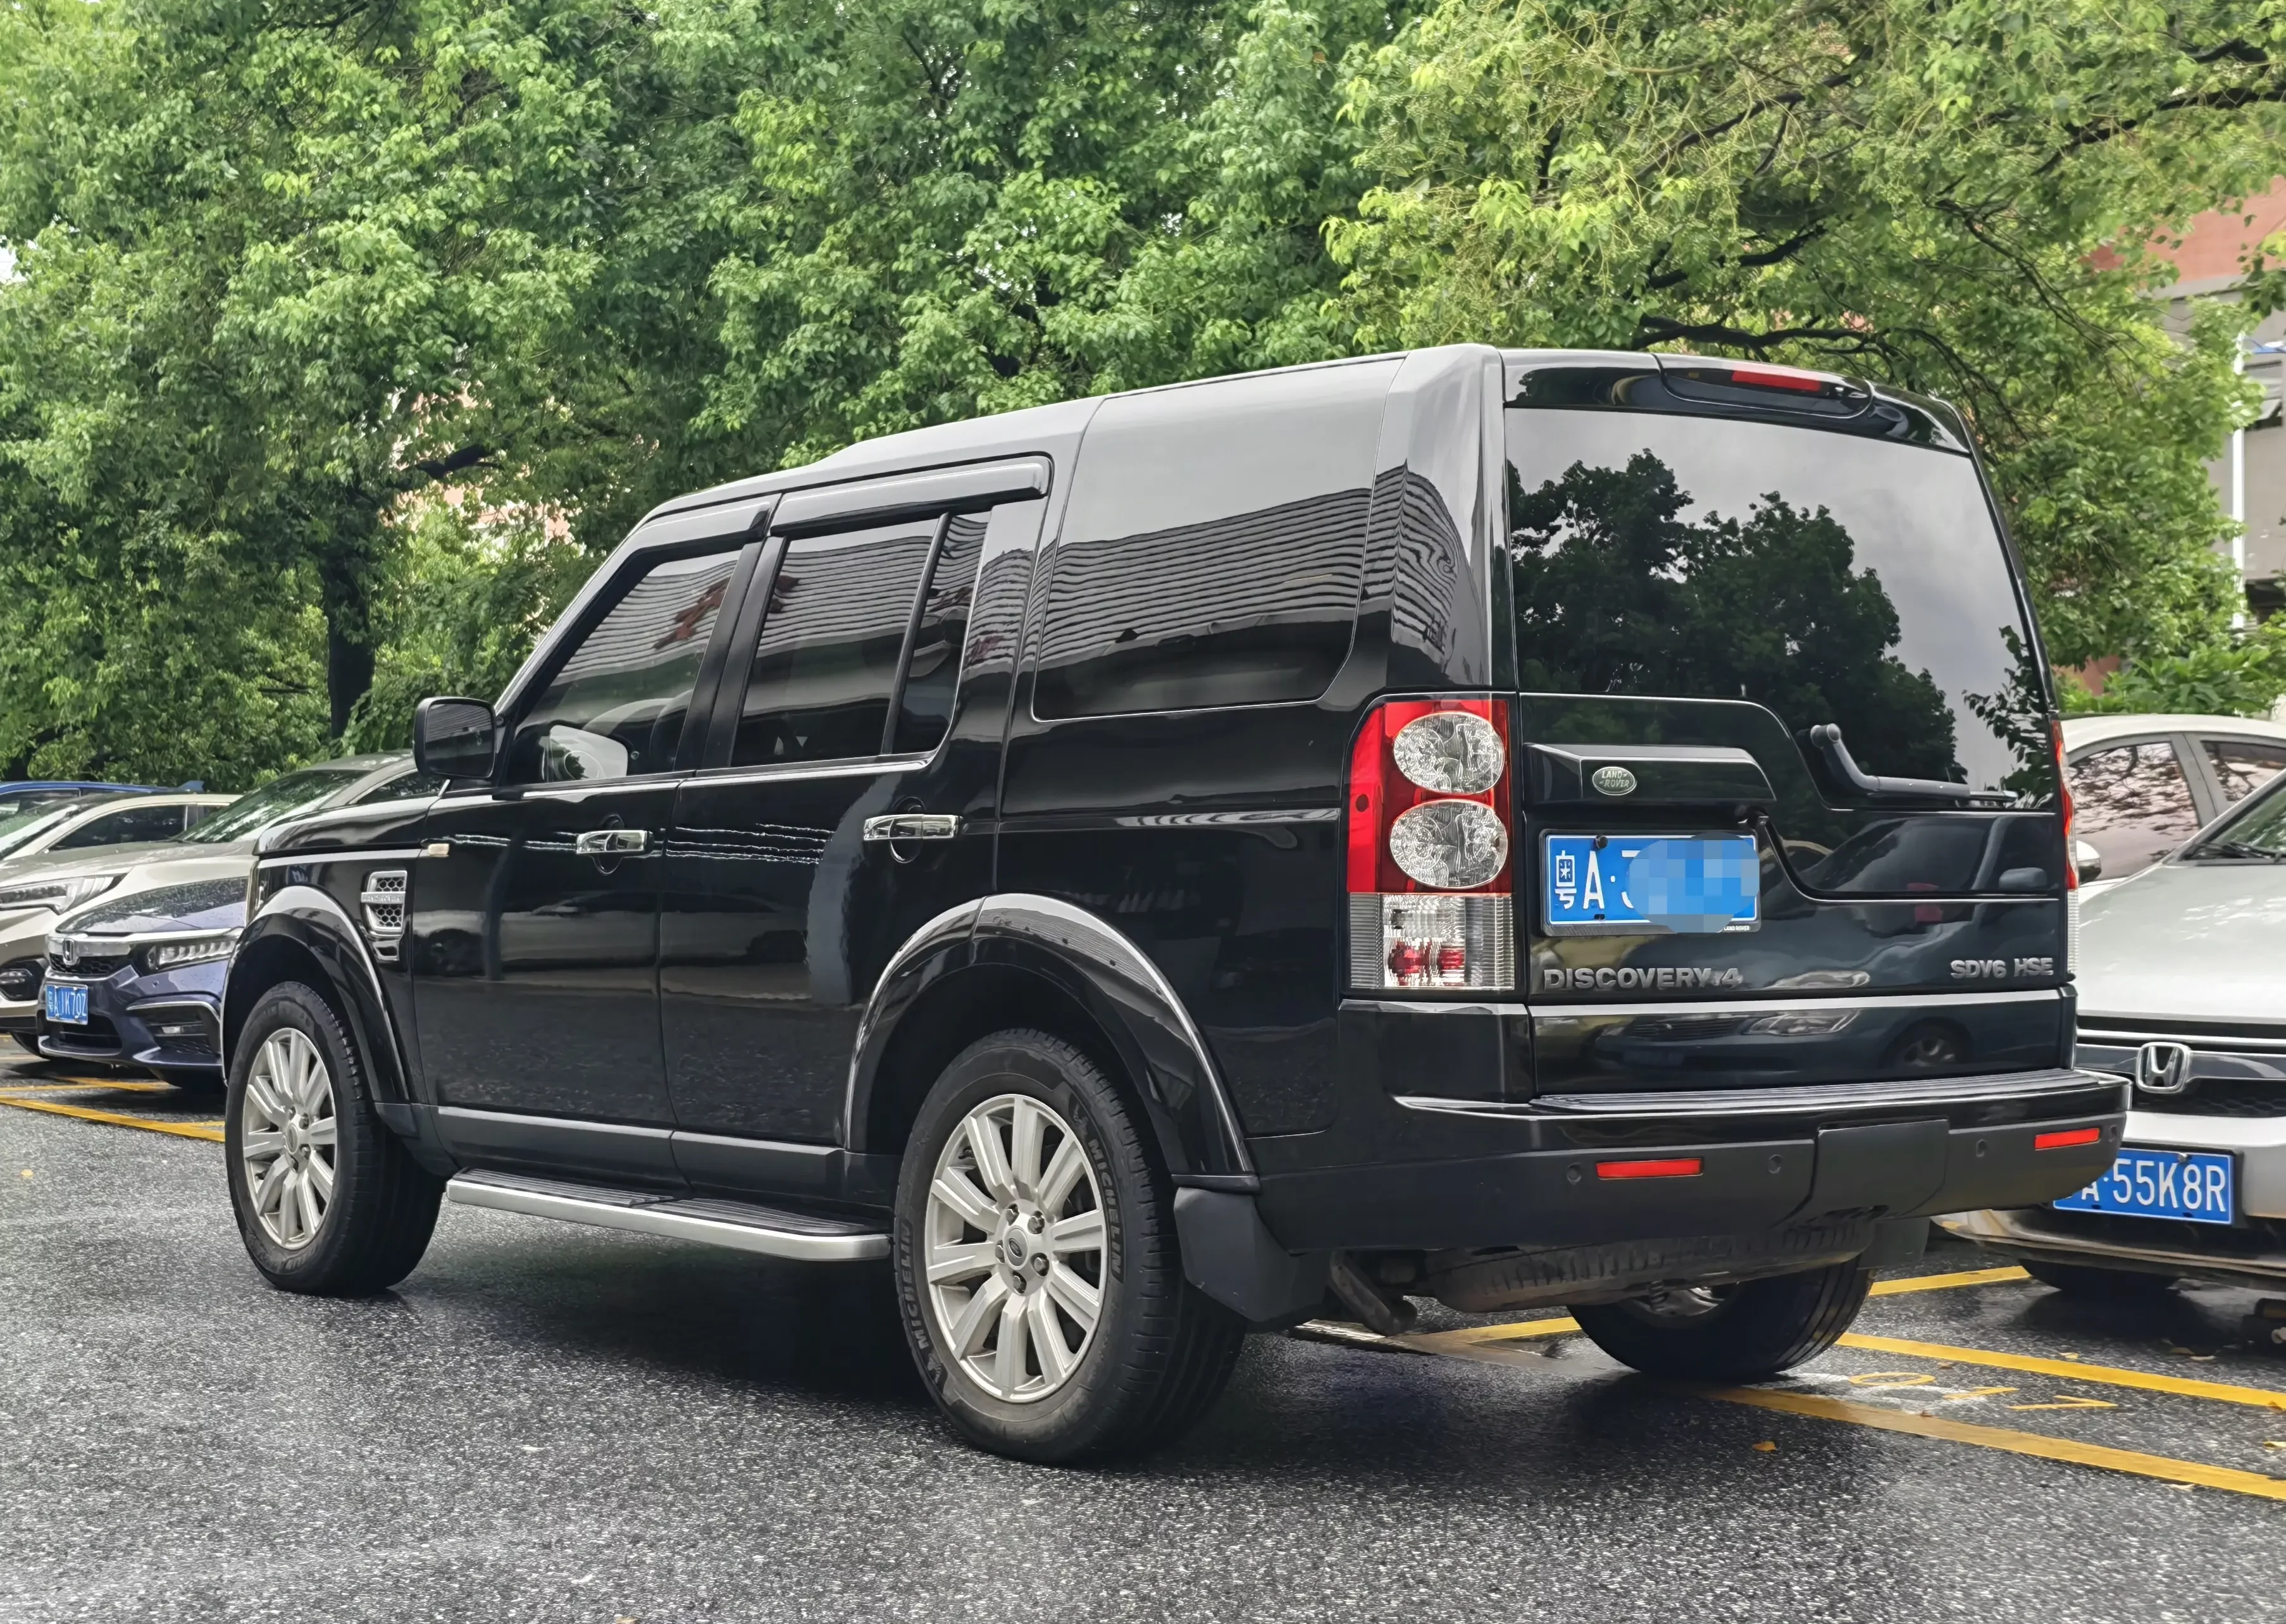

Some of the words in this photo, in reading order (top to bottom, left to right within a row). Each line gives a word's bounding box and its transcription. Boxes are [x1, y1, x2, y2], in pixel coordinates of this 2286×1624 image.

[1601, 770, 1623, 779] LAND
[1603, 779, 1630, 788] ROVER
[1544, 968, 1711, 989] DISCOVERY
[1722, 968, 1744, 989] 4
[1951, 960, 2006, 979] SDV6
[2014, 957, 2054, 977] HSE
[1088, 1139, 1122, 1275] MICHELIN
[901, 1222, 929, 1350] MICHELIN
